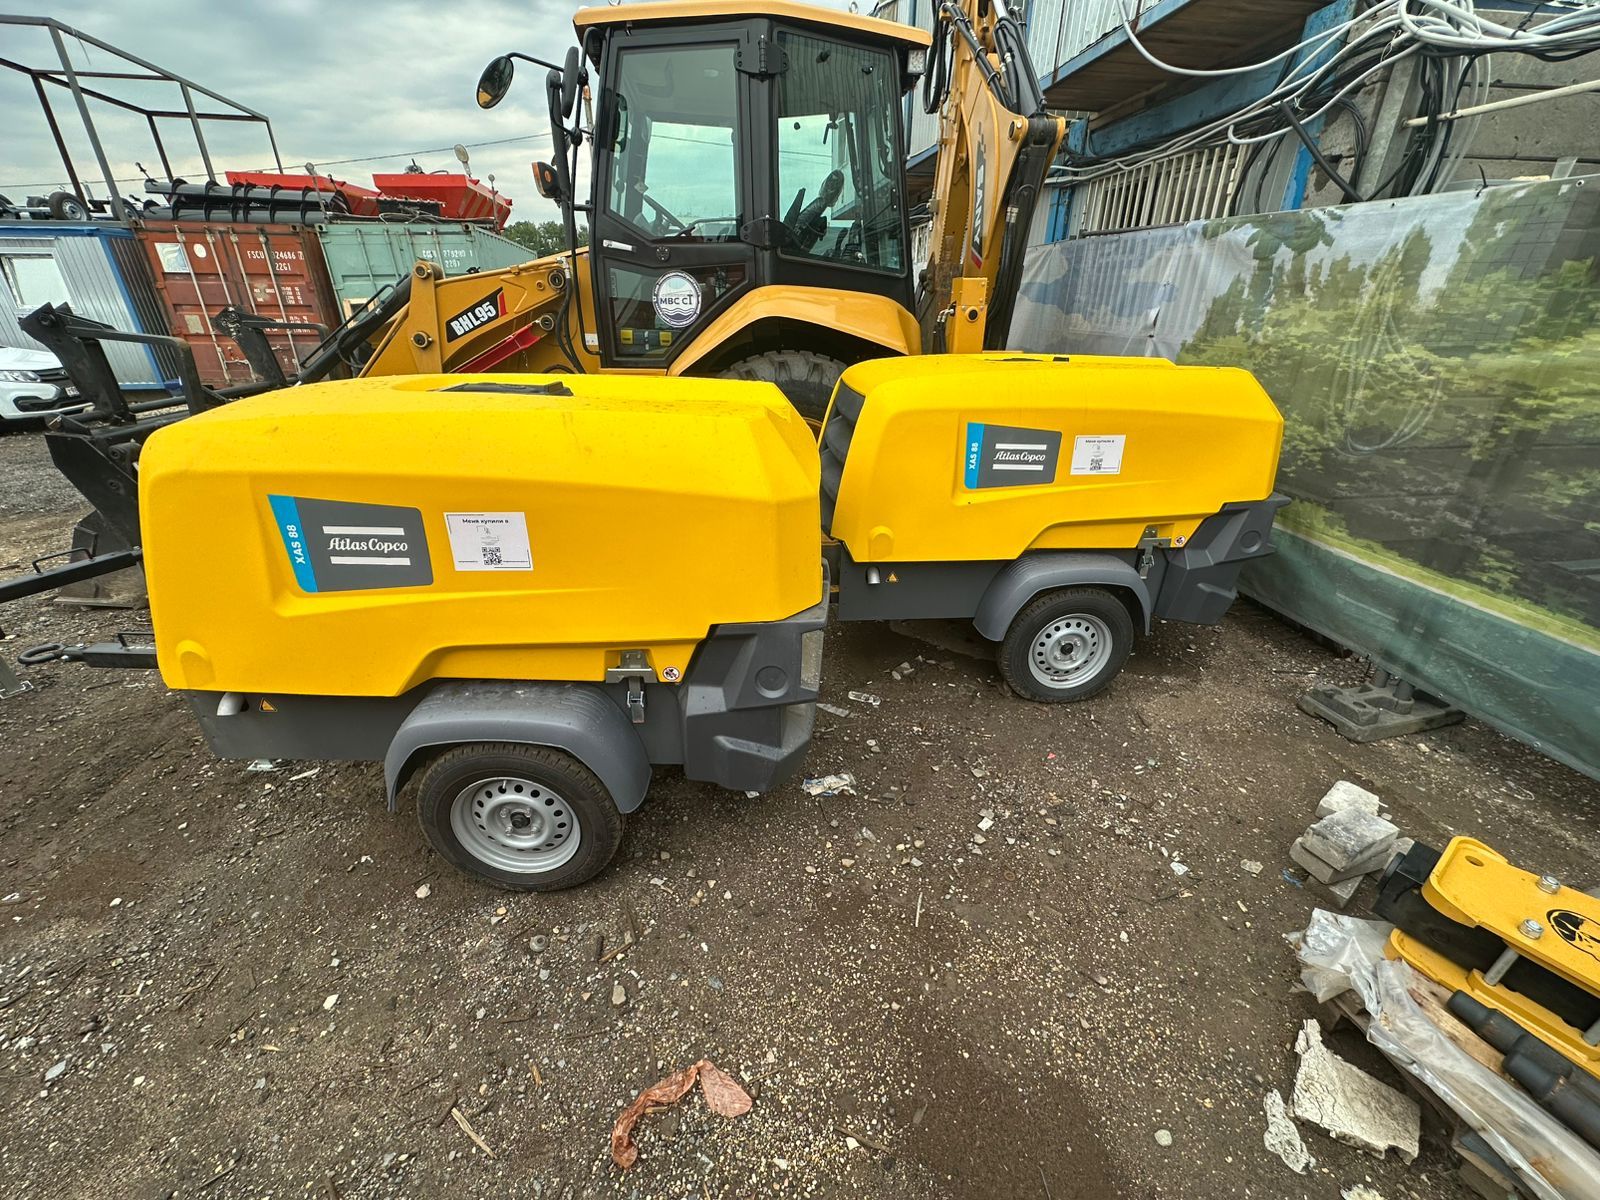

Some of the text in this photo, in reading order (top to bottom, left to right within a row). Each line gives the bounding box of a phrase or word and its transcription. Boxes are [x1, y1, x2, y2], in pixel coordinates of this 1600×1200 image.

[450, 301, 496, 336] BHL95
[968, 442, 979, 470] XAS 88
[993, 450, 1046, 463] Atlas Copco
[286, 524, 306, 565] XAS 88
[327, 537, 409, 554] Atlas Copco
